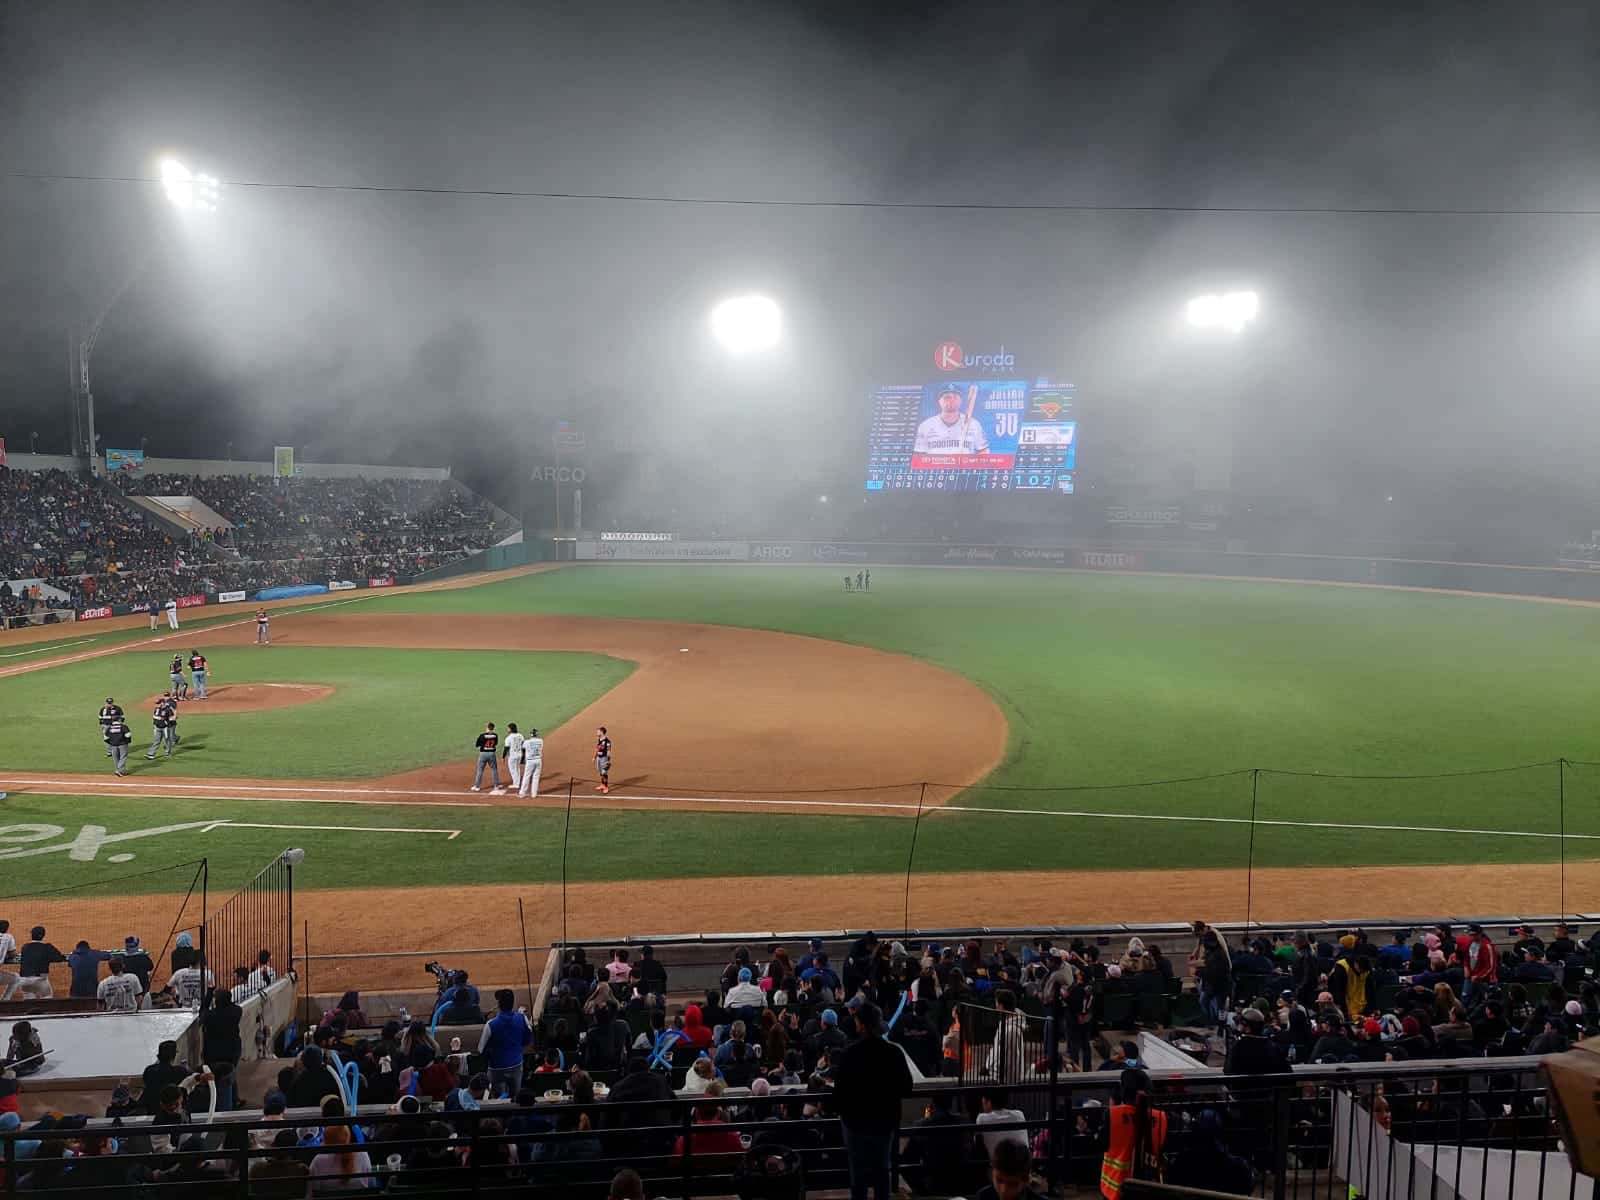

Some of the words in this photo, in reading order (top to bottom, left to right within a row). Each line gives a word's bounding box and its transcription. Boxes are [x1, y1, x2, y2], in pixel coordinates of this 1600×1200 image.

[942, 343, 1015, 368] Kuroda
[995, 412, 1019, 437] 30
[530, 466, 586, 482] ARCO
[751, 545, 793, 560] ARCO
